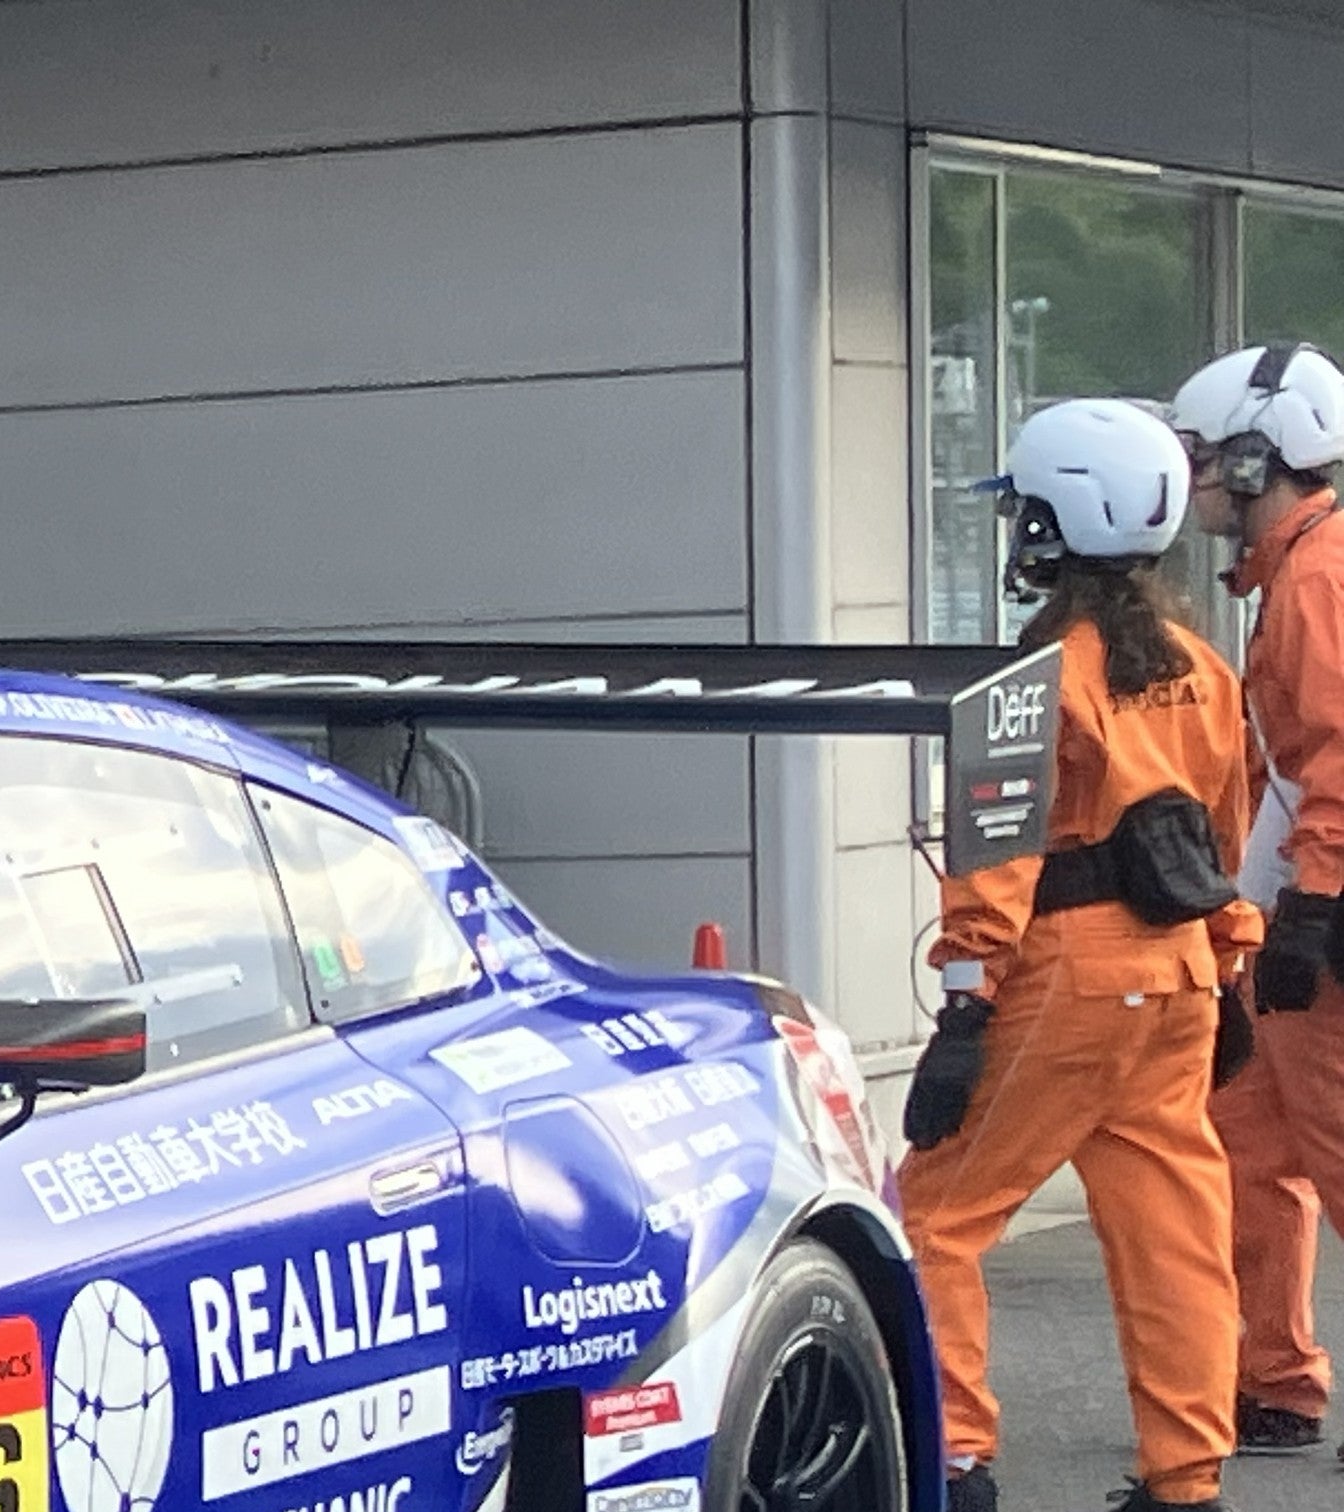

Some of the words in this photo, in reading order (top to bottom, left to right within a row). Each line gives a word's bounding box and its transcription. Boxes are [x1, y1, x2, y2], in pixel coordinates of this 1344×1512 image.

[20, 1099, 308, 1225] 日産自動車大学校
[189, 1224, 448, 1393] REALIZE
[522, 1269, 667, 1335] Logisnext
[243, 1388, 414, 1475] GROUP
